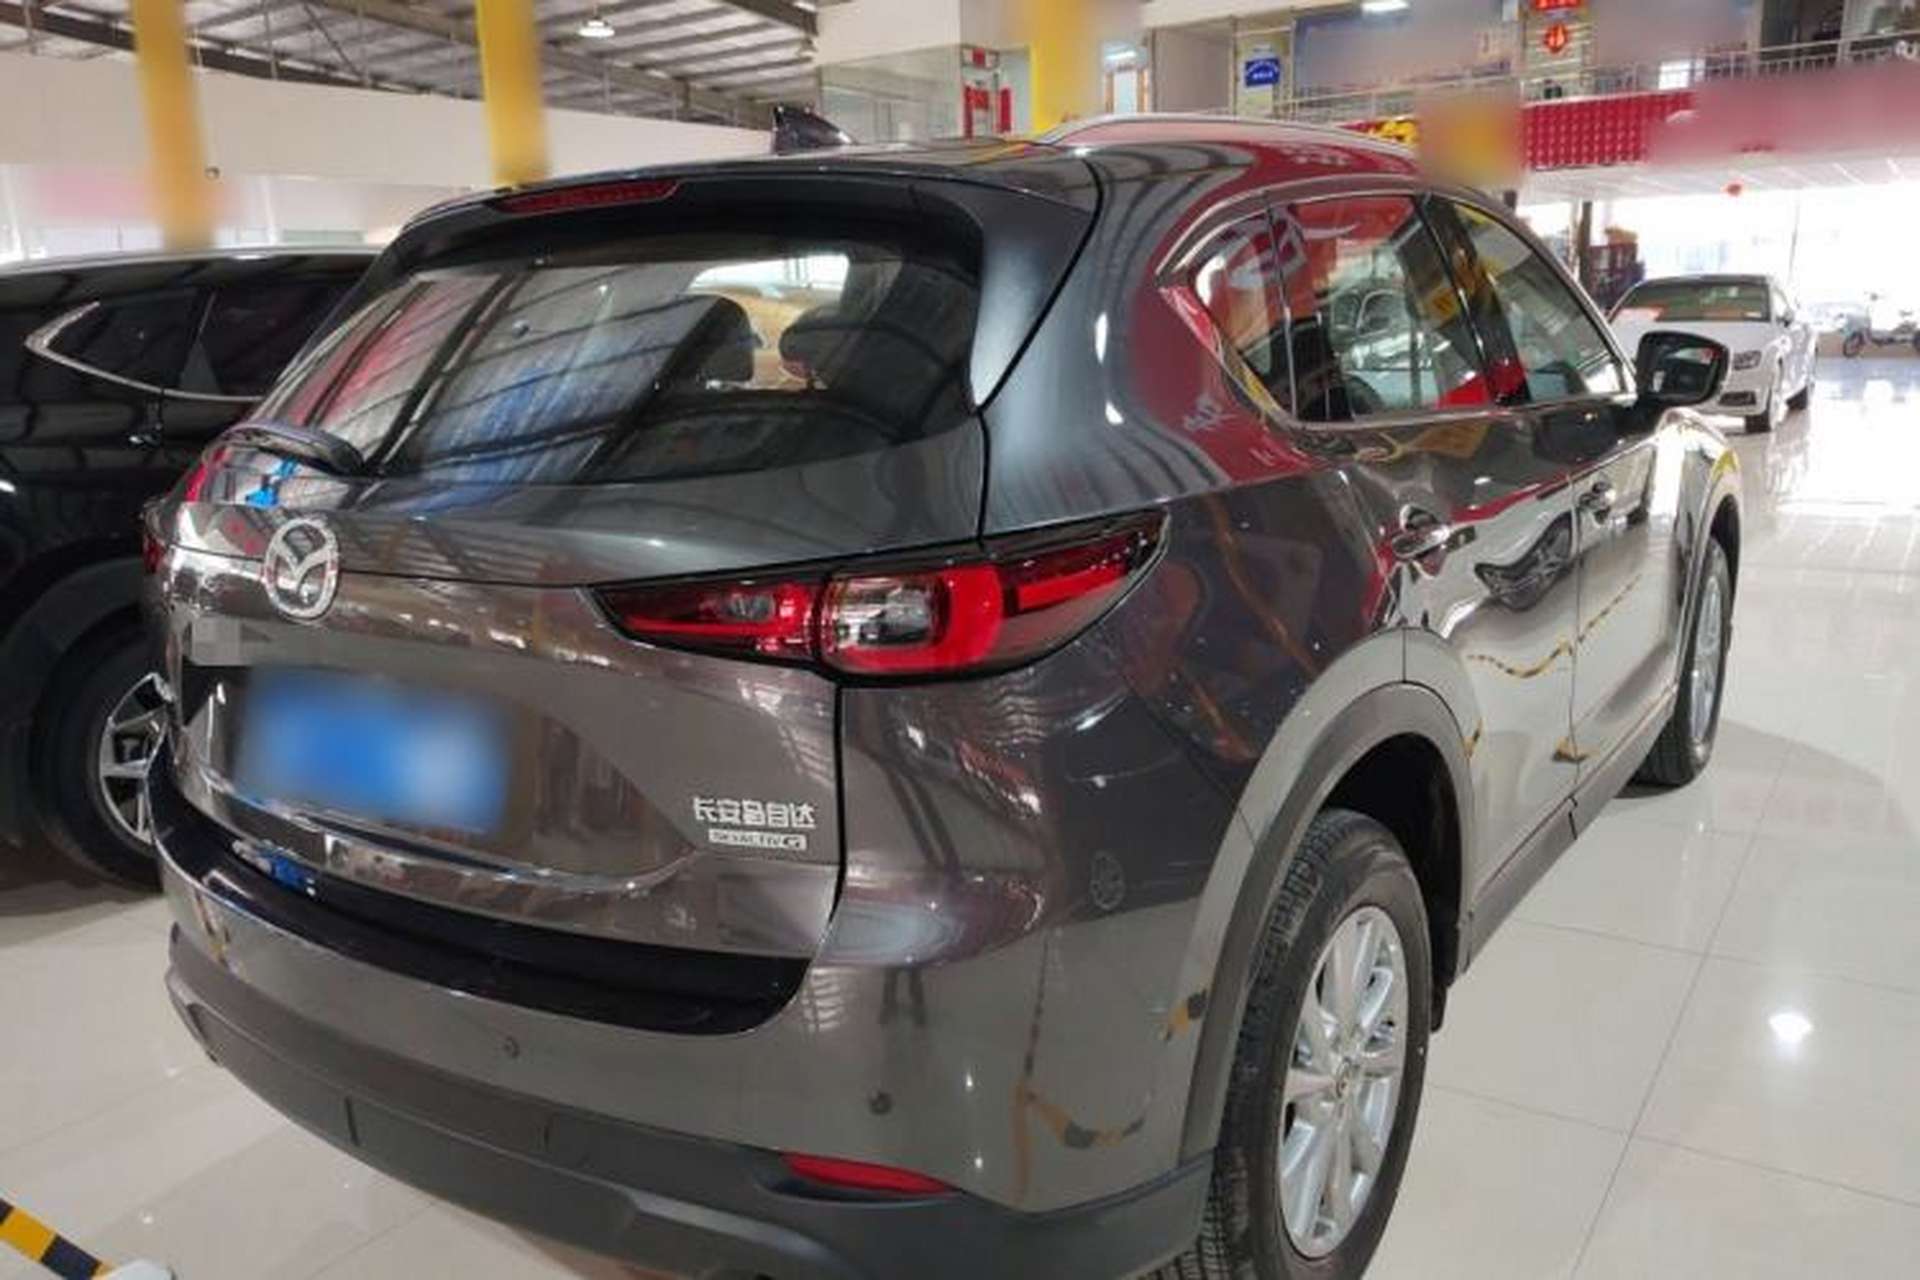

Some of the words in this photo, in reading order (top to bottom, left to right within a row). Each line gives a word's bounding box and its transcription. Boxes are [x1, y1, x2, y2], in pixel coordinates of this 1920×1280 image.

[693, 797, 816, 829] 长安马自达
